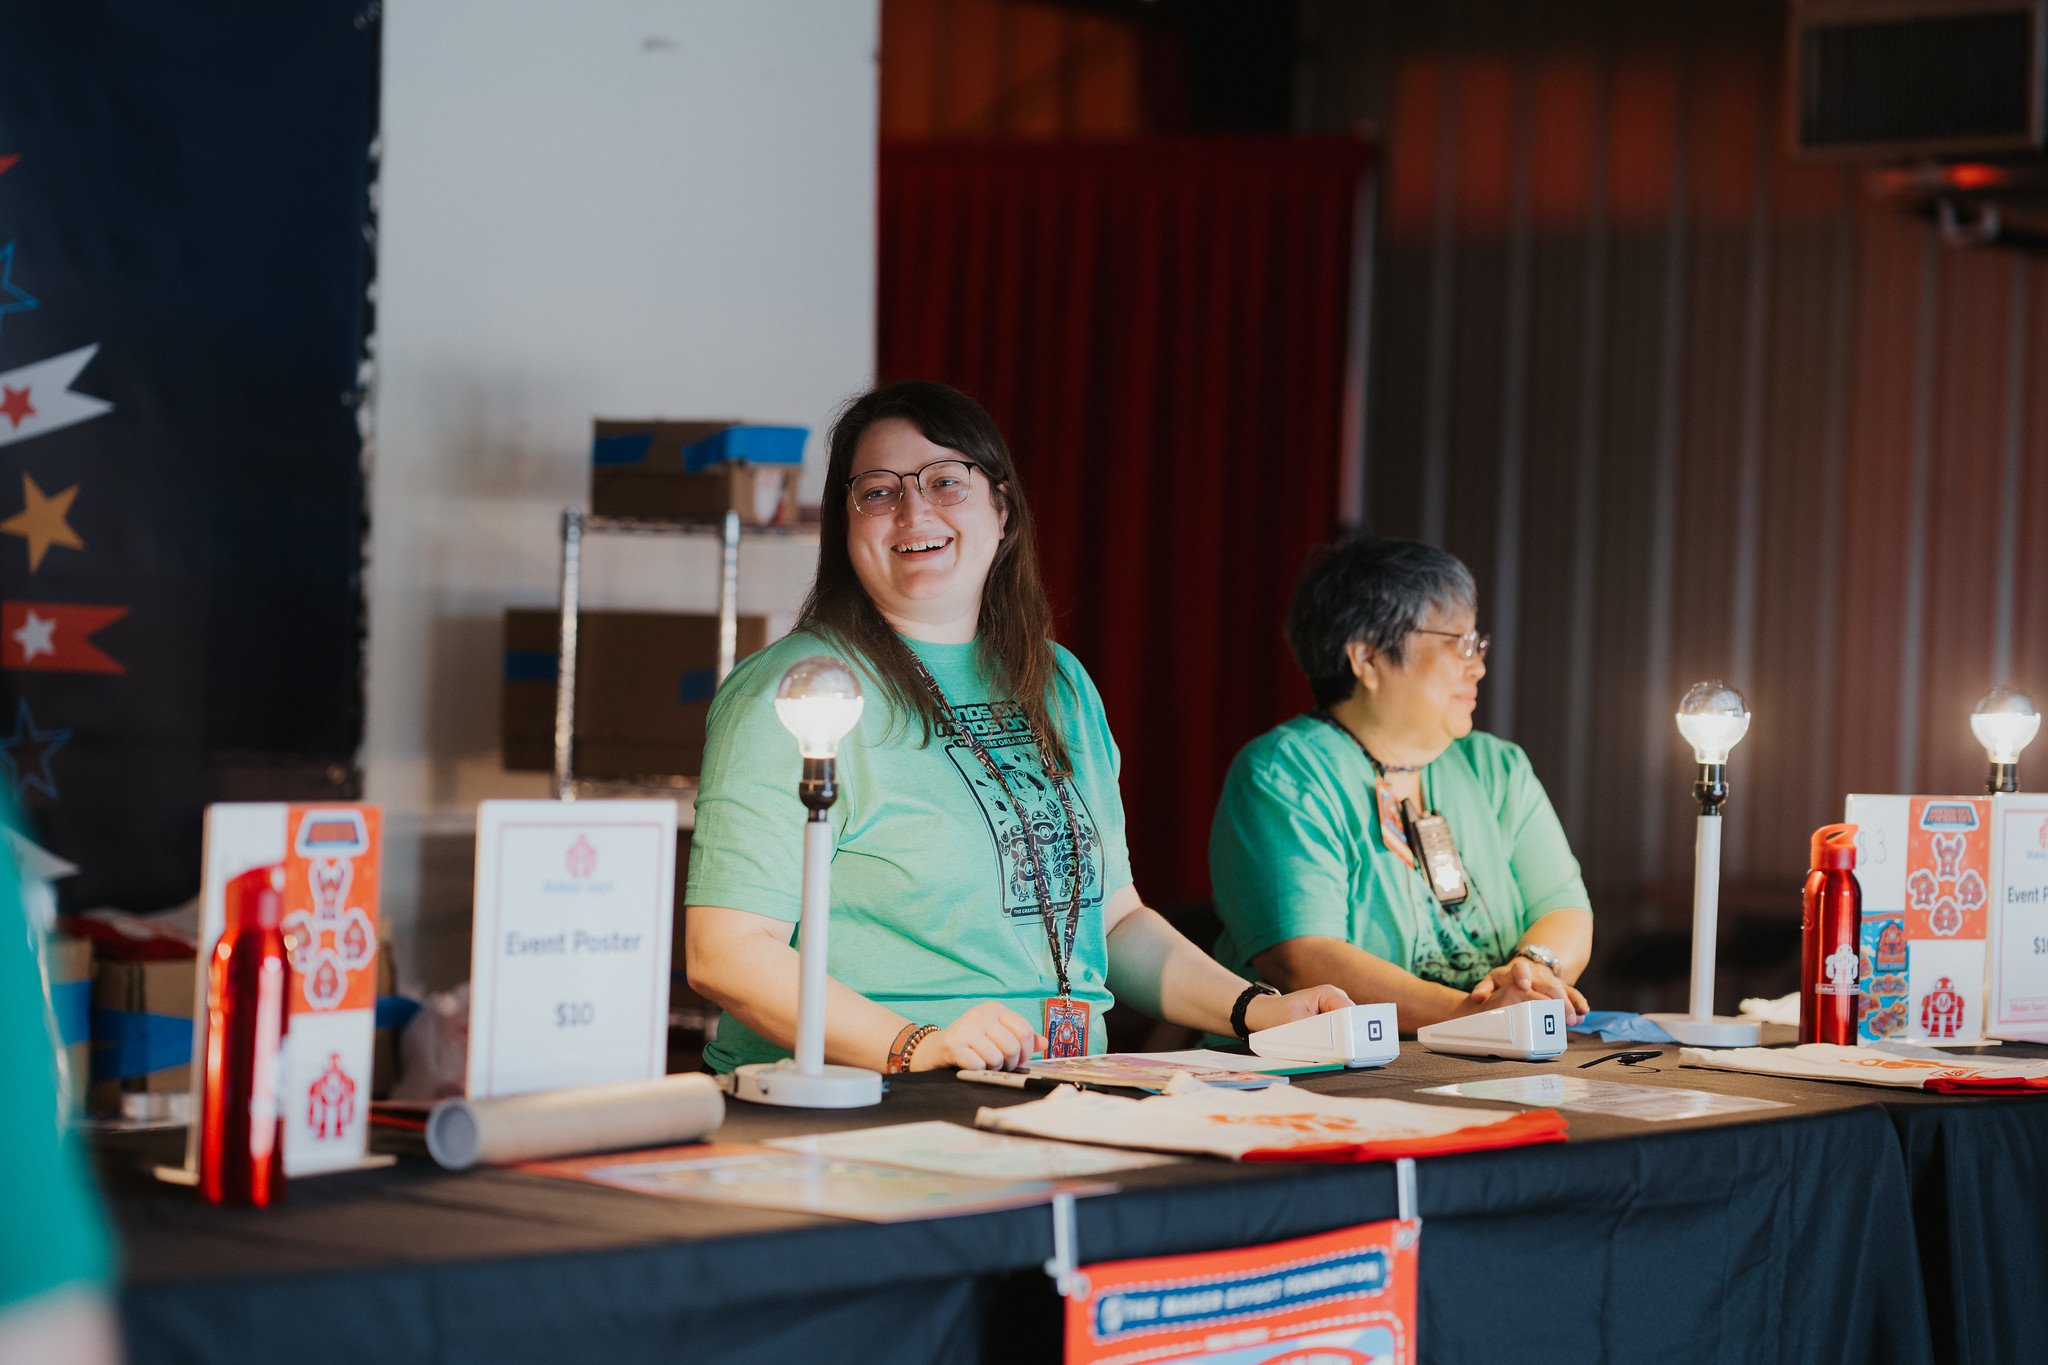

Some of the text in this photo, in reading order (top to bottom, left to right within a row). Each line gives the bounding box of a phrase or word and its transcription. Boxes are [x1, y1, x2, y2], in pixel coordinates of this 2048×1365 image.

[2007, 885, 2039, 903] Event
[505, 930, 641, 955] Event Poster
[556, 1002, 595, 1027] $10
